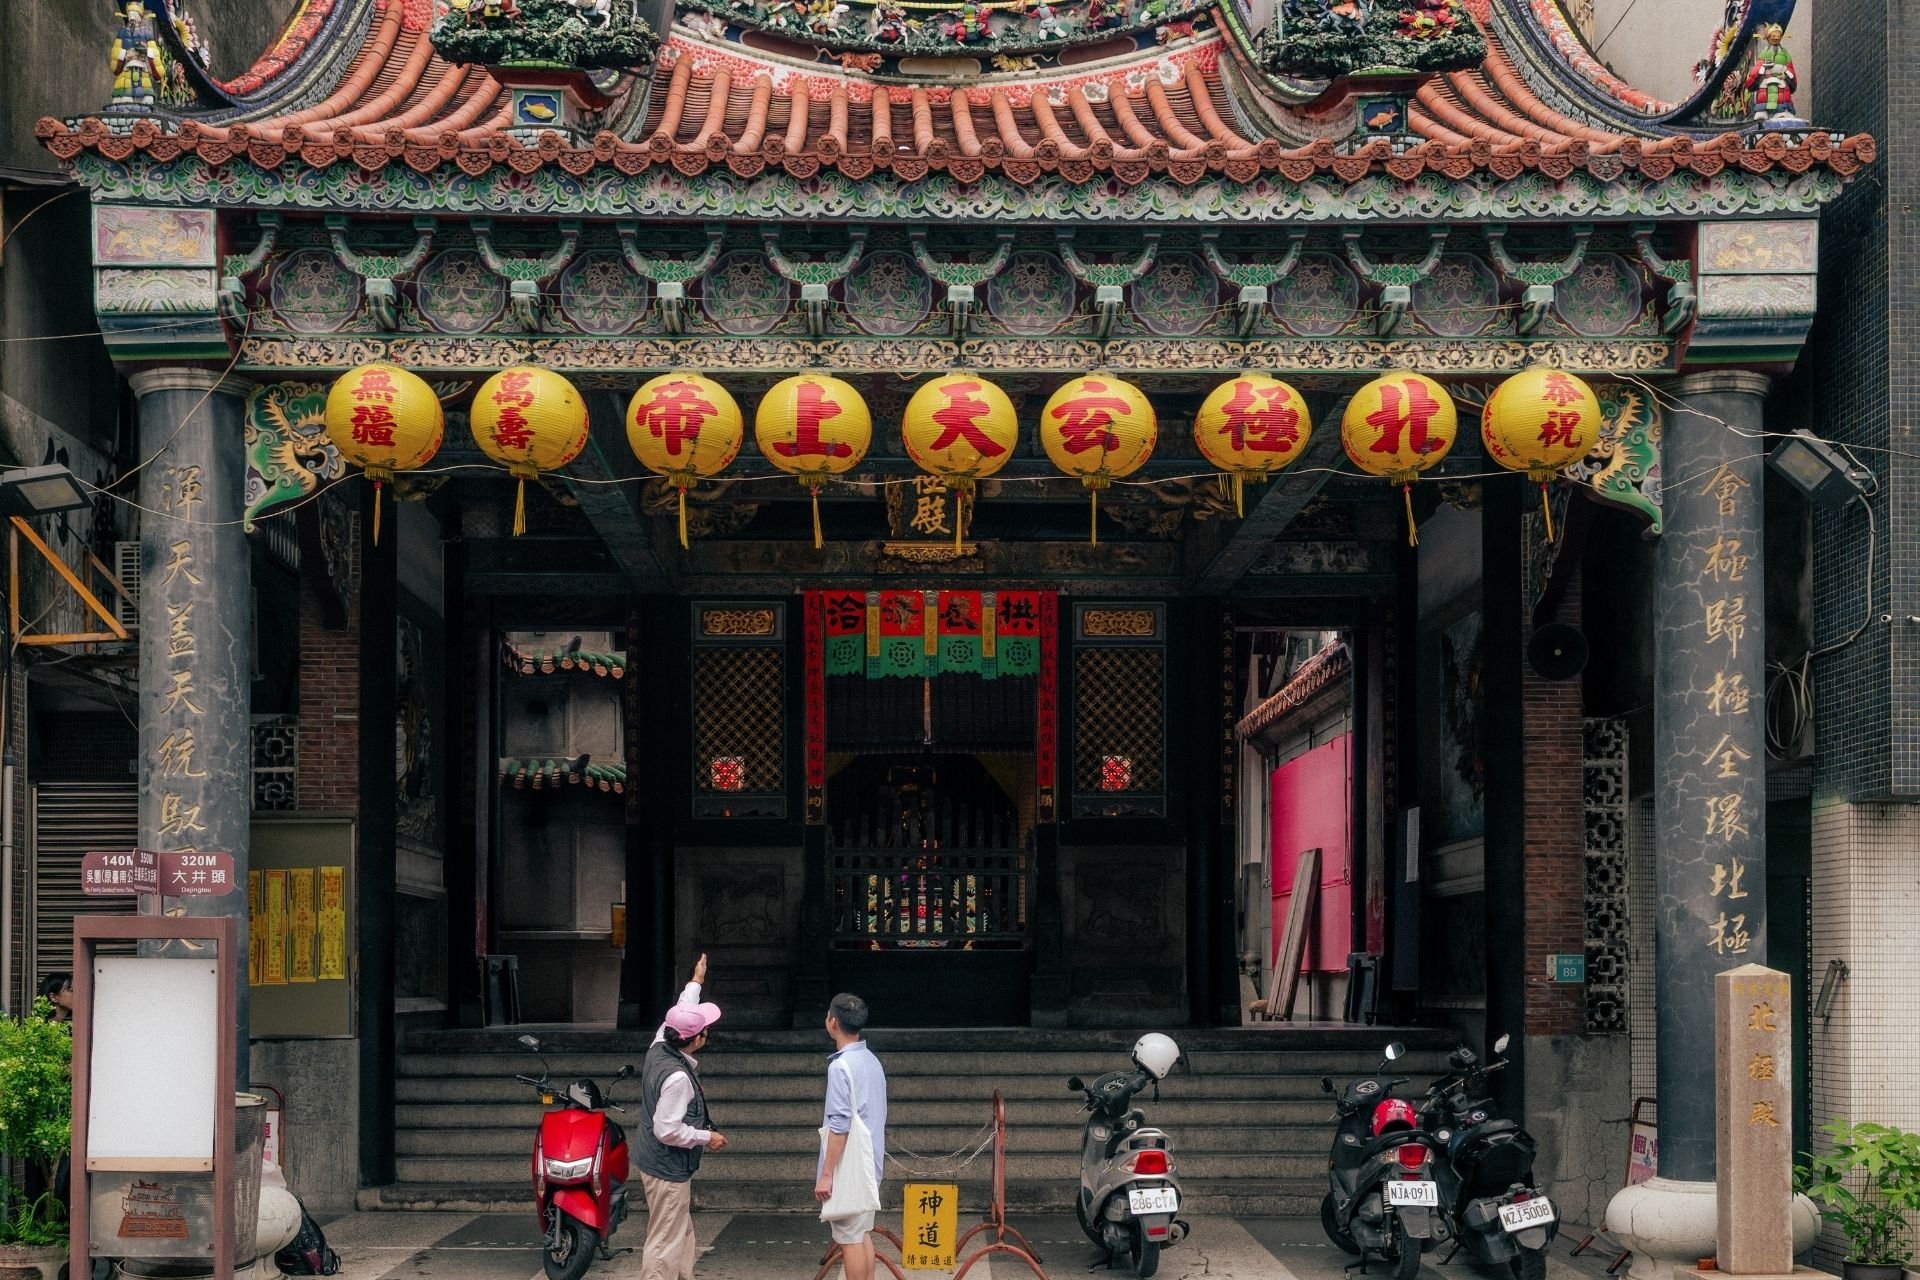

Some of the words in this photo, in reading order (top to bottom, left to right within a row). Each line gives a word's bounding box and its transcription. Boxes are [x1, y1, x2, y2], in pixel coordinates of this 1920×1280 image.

[350, 369, 398, 447] 無疆
[490, 372, 536, 449] 萬壽
[636, 381, 718, 455] 帝
[772, 383, 853, 457] 上
[929, 381, 1007, 457] 天
[1218, 381, 1300, 452] 極
[1366, 379, 1446, 454] 北
[102, 855, 133, 866] 140M
[172, 869, 226, 884] 大井頭
[181, 855, 217, 866] 320M
[181, 886, 212, 894] Dajingtou
[1563, 967, 1577, 977] 89
[1748, 1001, 1781, 1127] 北極殿
[918, 1190, 944, 1248] 神道
[906, 1254, 953, 1266] 請留通道
